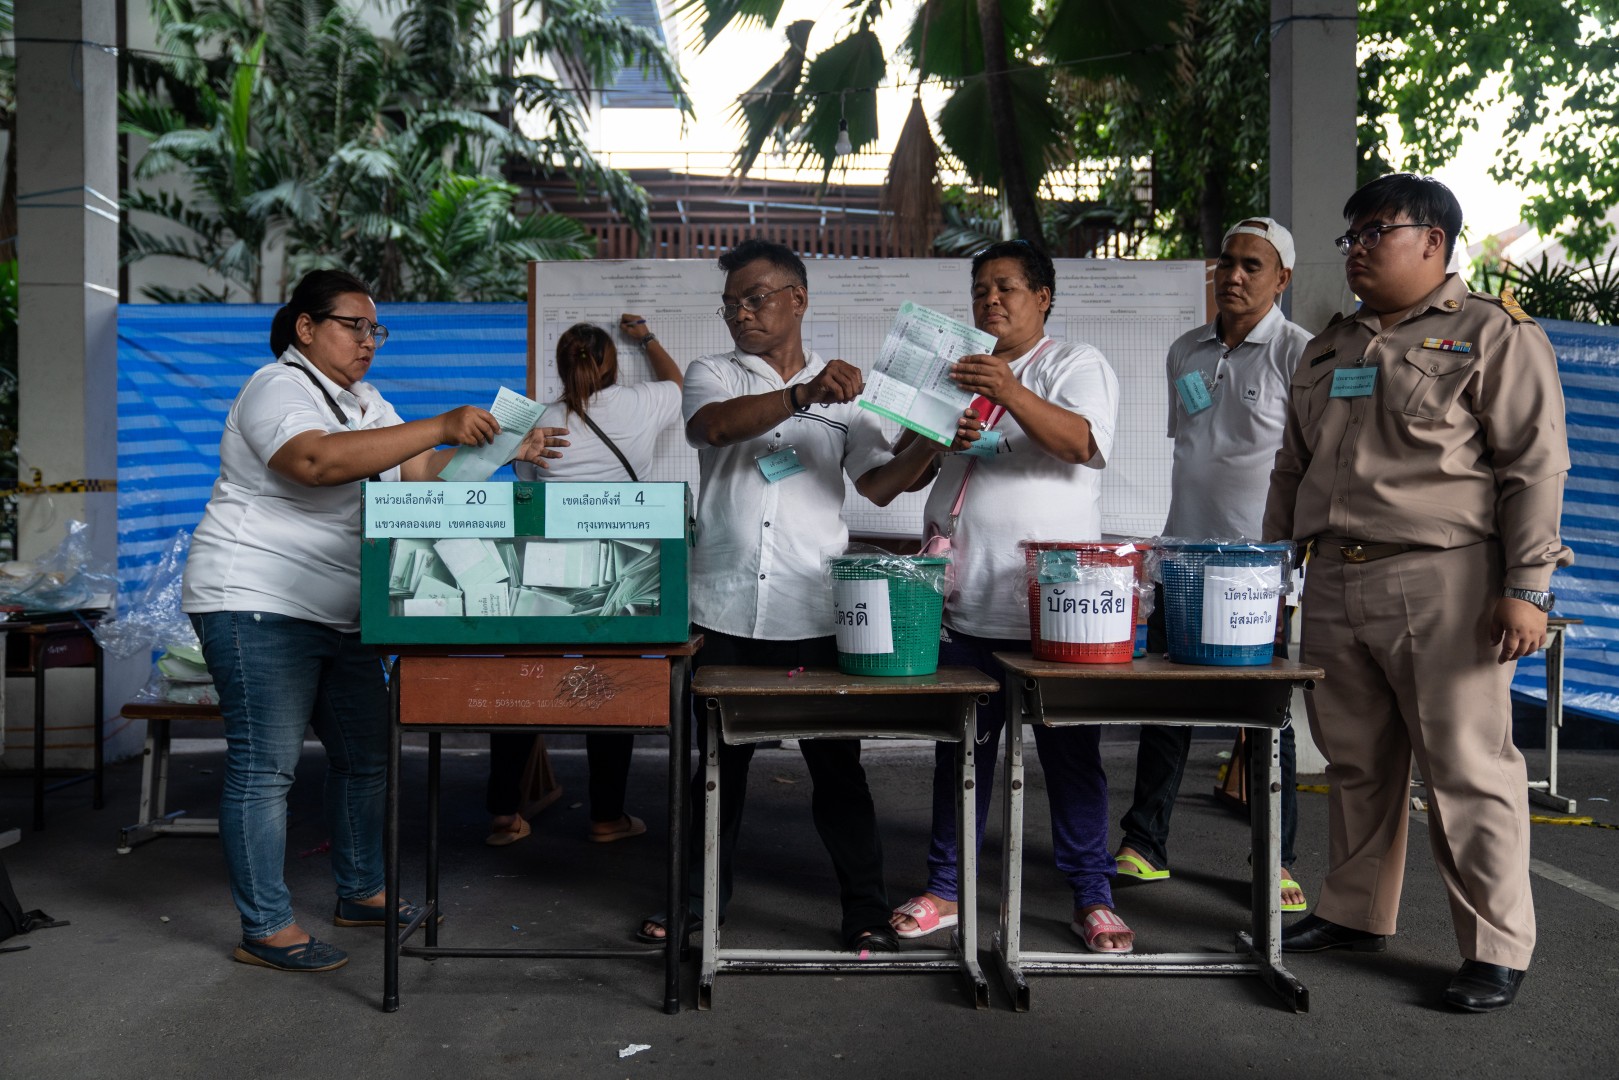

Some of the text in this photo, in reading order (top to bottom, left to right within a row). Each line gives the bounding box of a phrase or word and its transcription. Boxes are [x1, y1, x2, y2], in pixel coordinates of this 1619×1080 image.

[375, 489, 487, 506] หน่วยเลือกตั้งที่ 20
[562, 489, 645, 506] เขตเลือกตั้งที่ 4
[375, 518, 506, 530] แขวงคลองเตย เขตคลองเตย
[577, 518, 650, 532] กรุงเทพมหานคร
[1047, 588, 1126, 614] บัตรเสีย
[1229, 610, 1272, 629] ผู้สมัครใด
[520, 664, 544, 679] 5/2
